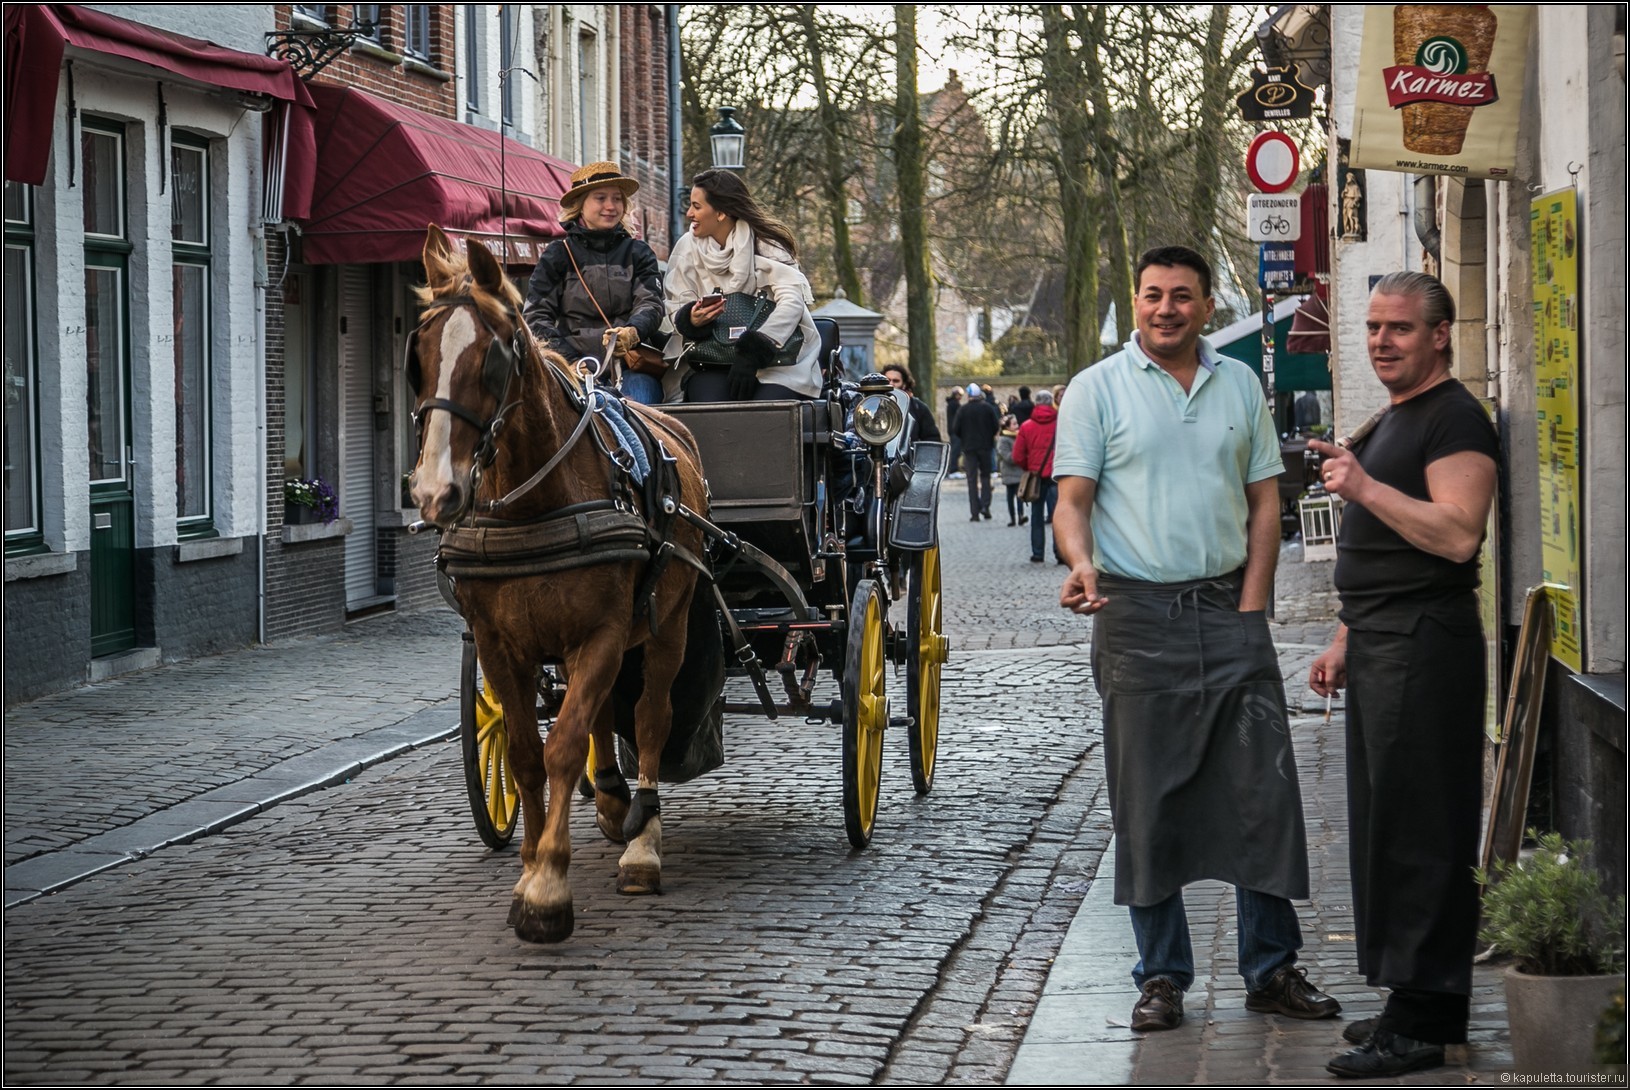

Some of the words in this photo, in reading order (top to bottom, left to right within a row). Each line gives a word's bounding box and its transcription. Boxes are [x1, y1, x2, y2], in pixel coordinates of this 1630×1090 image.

[1390, 70, 1486, 98] Karmez
[1396, 160, 1469, 174] www.karmez.com
[1251, 199, 1298, 208] UITGEZONDERD
